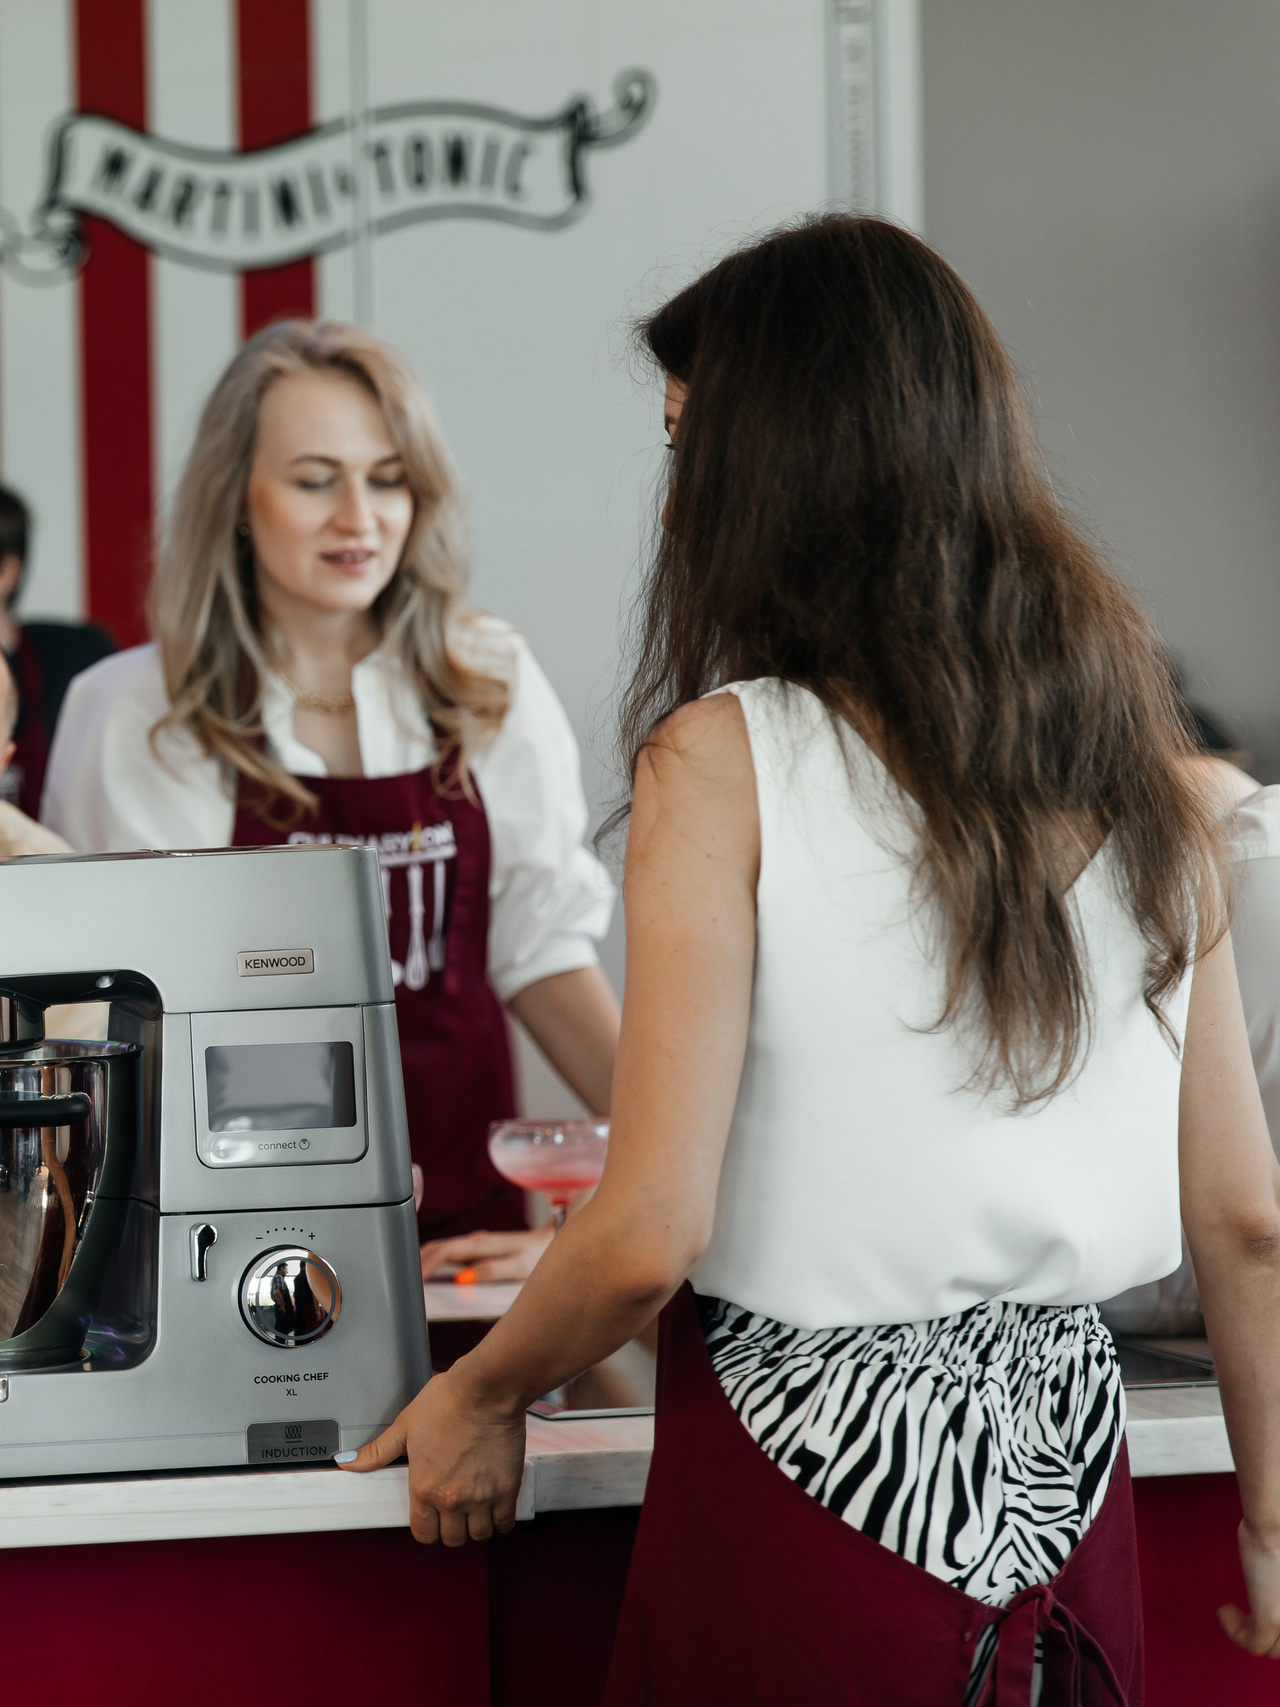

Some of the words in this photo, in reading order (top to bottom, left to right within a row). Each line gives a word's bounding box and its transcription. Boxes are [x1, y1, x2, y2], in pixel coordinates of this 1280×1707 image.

[90, 146, 331, 239] MARTINI
[366, 130, 535, 202] TONIC
[245, 956, 306, 970] KENWOOD
[258, 1140, 297, 1151] connect
[254, 1374, 300, 1384] COOKING
[303, 1372, 329, 1381] CHEF
[286, 1388, 297, 1396] XL
[262, 1446, 327, 1458] INDUCTION
